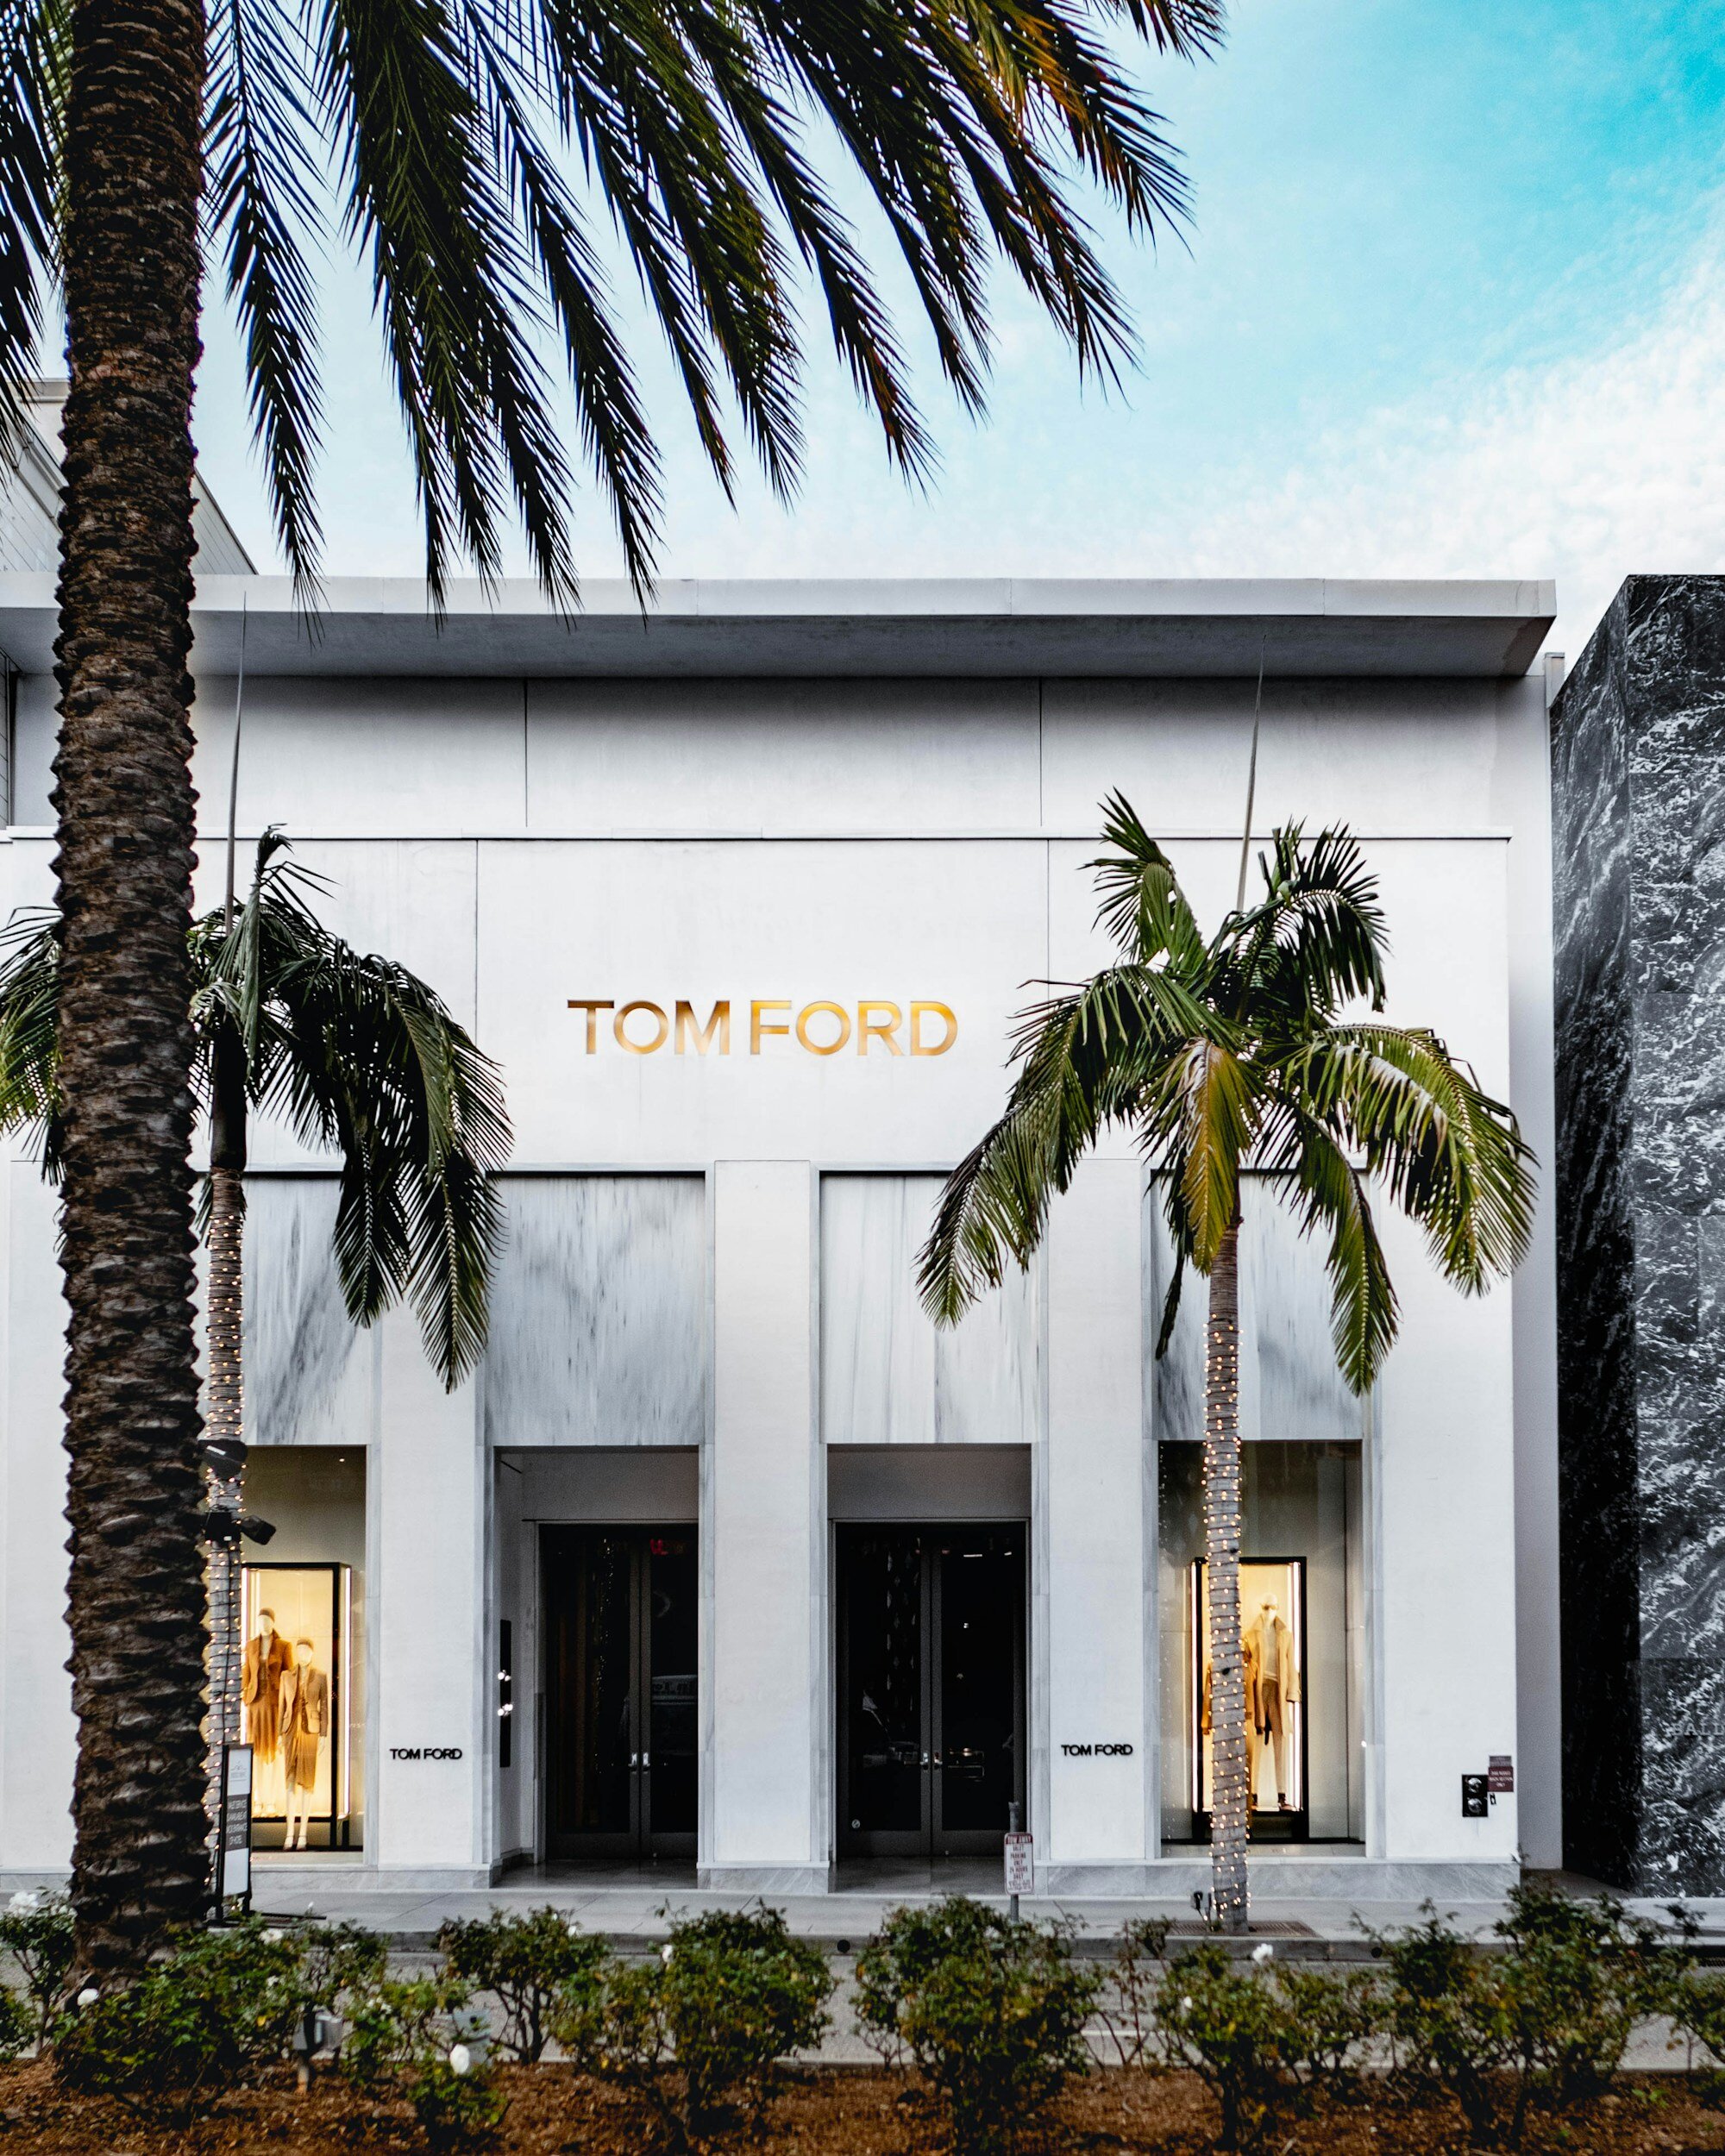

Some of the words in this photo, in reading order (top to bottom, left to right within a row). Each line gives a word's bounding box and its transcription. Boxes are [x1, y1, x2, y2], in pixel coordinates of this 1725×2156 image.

[567, 1000, 731, 1056] TOM
[750, 999, 958, 1056] FORD
[389, 1748, 421, 1760] TOM
[423, 1748, 463, 1760] FORD
[1061, 1744, 1092, 1756] TOM
[1095, 1744, 1133, 1756] FORD
